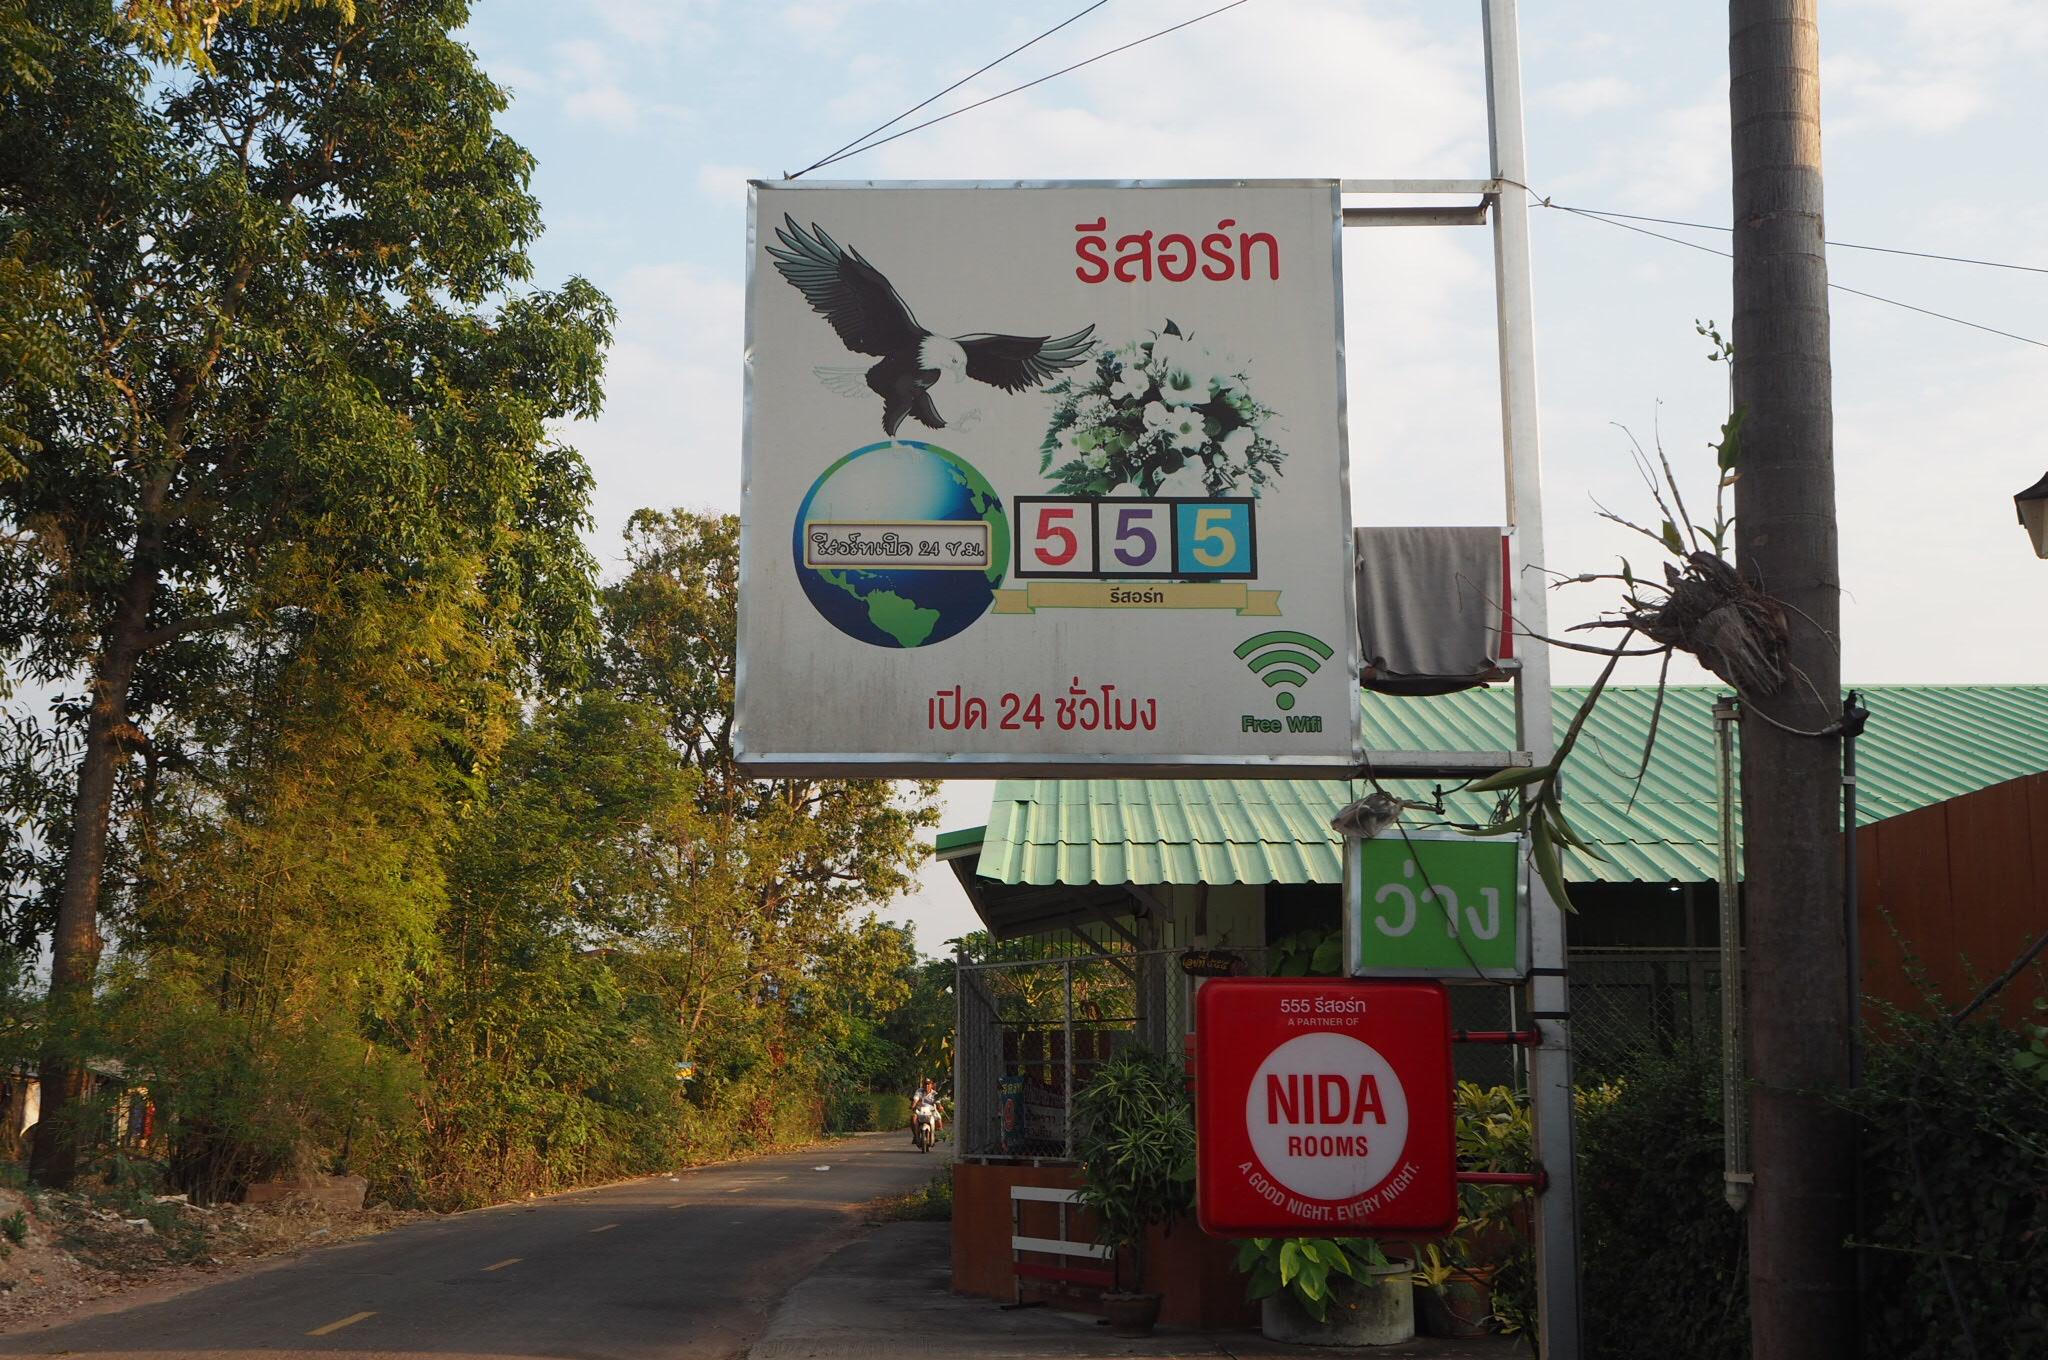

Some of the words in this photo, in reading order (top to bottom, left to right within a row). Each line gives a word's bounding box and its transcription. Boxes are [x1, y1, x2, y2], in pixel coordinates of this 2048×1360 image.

[1076, 217, 1280, 284] รีสอร์ท
[918, 541, 940, 556] 24
[1110, 587, 1164, 604] รีสอร์ท
[929, 688, 988, 731] เปิด
[1001, 693, 1044, 731] 24
[1057, 678, 1157, 731] ชั่วโมง
[1241, 715, 1282, 732] Free
[1286, 715, 1322, 732] Wifi
[1374, 859, 1502, 940] ว่าง
[1280, 999, 1311, 1013] 555
[1314, 996, 1367, 1013] รีสอร์ท
[1288, 1018, 1295, 1026] A
[1297, 1017, 1343, 1026] PARTNER
[1345, 1017, 1360, 1026] OF
[1267, 1074, 1386, 1125] NIDA
[1288, 1135, 1368, 1157] ROOMS
[1238, 1161, 1253, 1175] A
[1248, 1172, 1286, 1206] GOOD
[1286, 1198, 1334, 1221] NIGHT.
[1337, 1194, 1381, 1221] EVERY
[1381, 1161, 1420, 1202] NIGHT.
